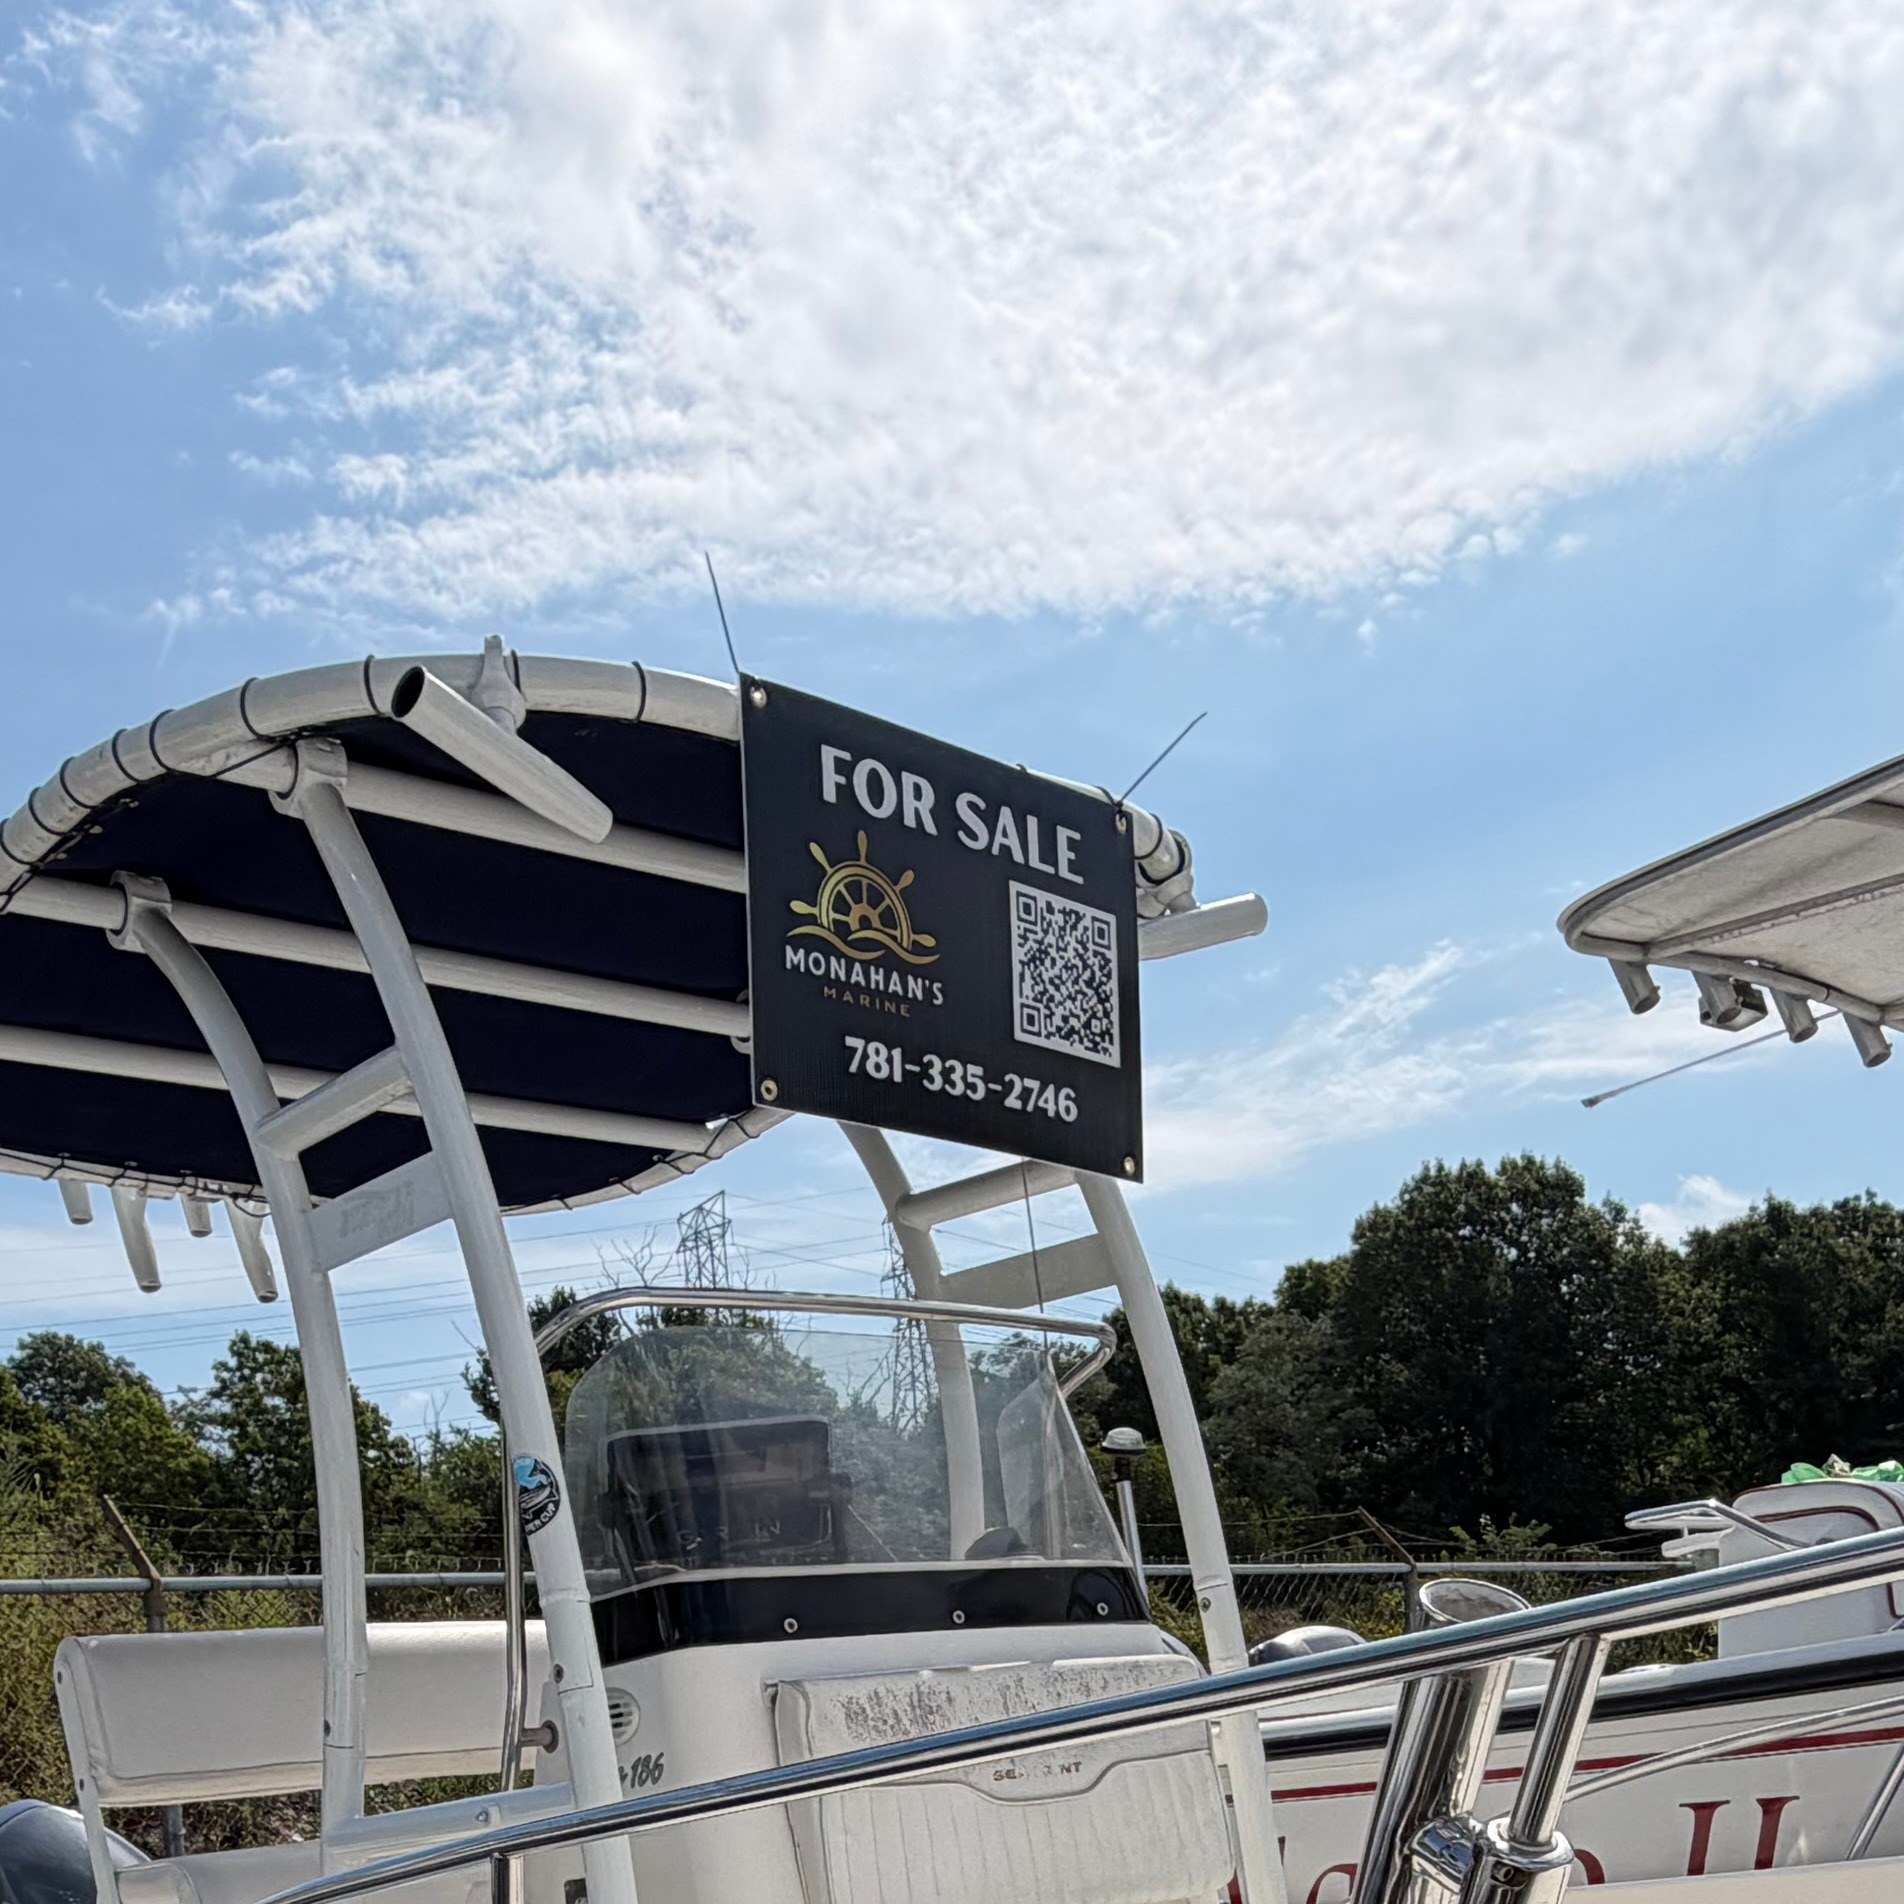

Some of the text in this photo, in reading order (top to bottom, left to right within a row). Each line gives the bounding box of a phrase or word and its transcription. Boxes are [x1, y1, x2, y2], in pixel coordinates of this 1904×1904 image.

[820, 743, 1085, 885] FOR SALE
[784, 944, 945, 1006] MONAHAN'S
[823, 985, 911, 1018] MARINE
[844, 1035, 1079, 1123] 781-335-2746
[629, 1751, 665, 1789] 186
